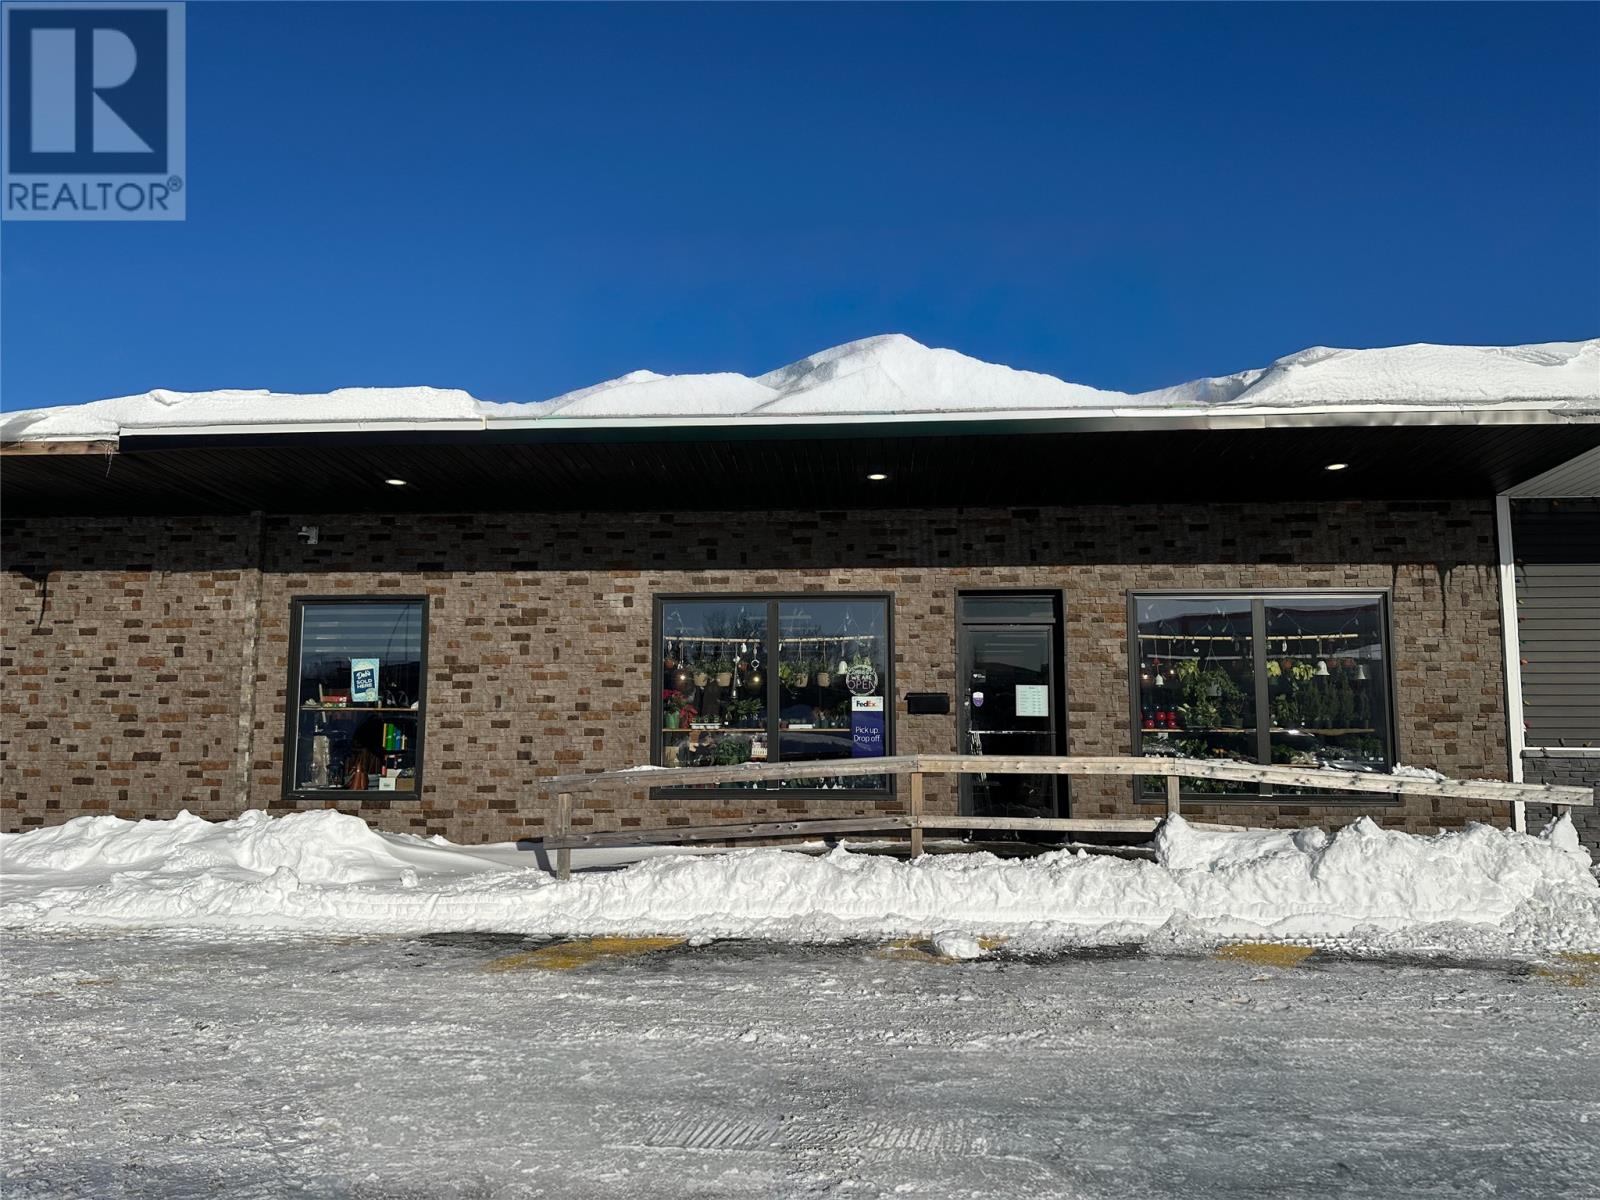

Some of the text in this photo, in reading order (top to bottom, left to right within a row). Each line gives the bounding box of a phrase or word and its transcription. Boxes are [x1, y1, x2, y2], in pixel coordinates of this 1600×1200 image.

[847, 679, 876, 690] OPEN
[855, 726, 869, 734] Pick
[853, 734, 870, 743] Drop
